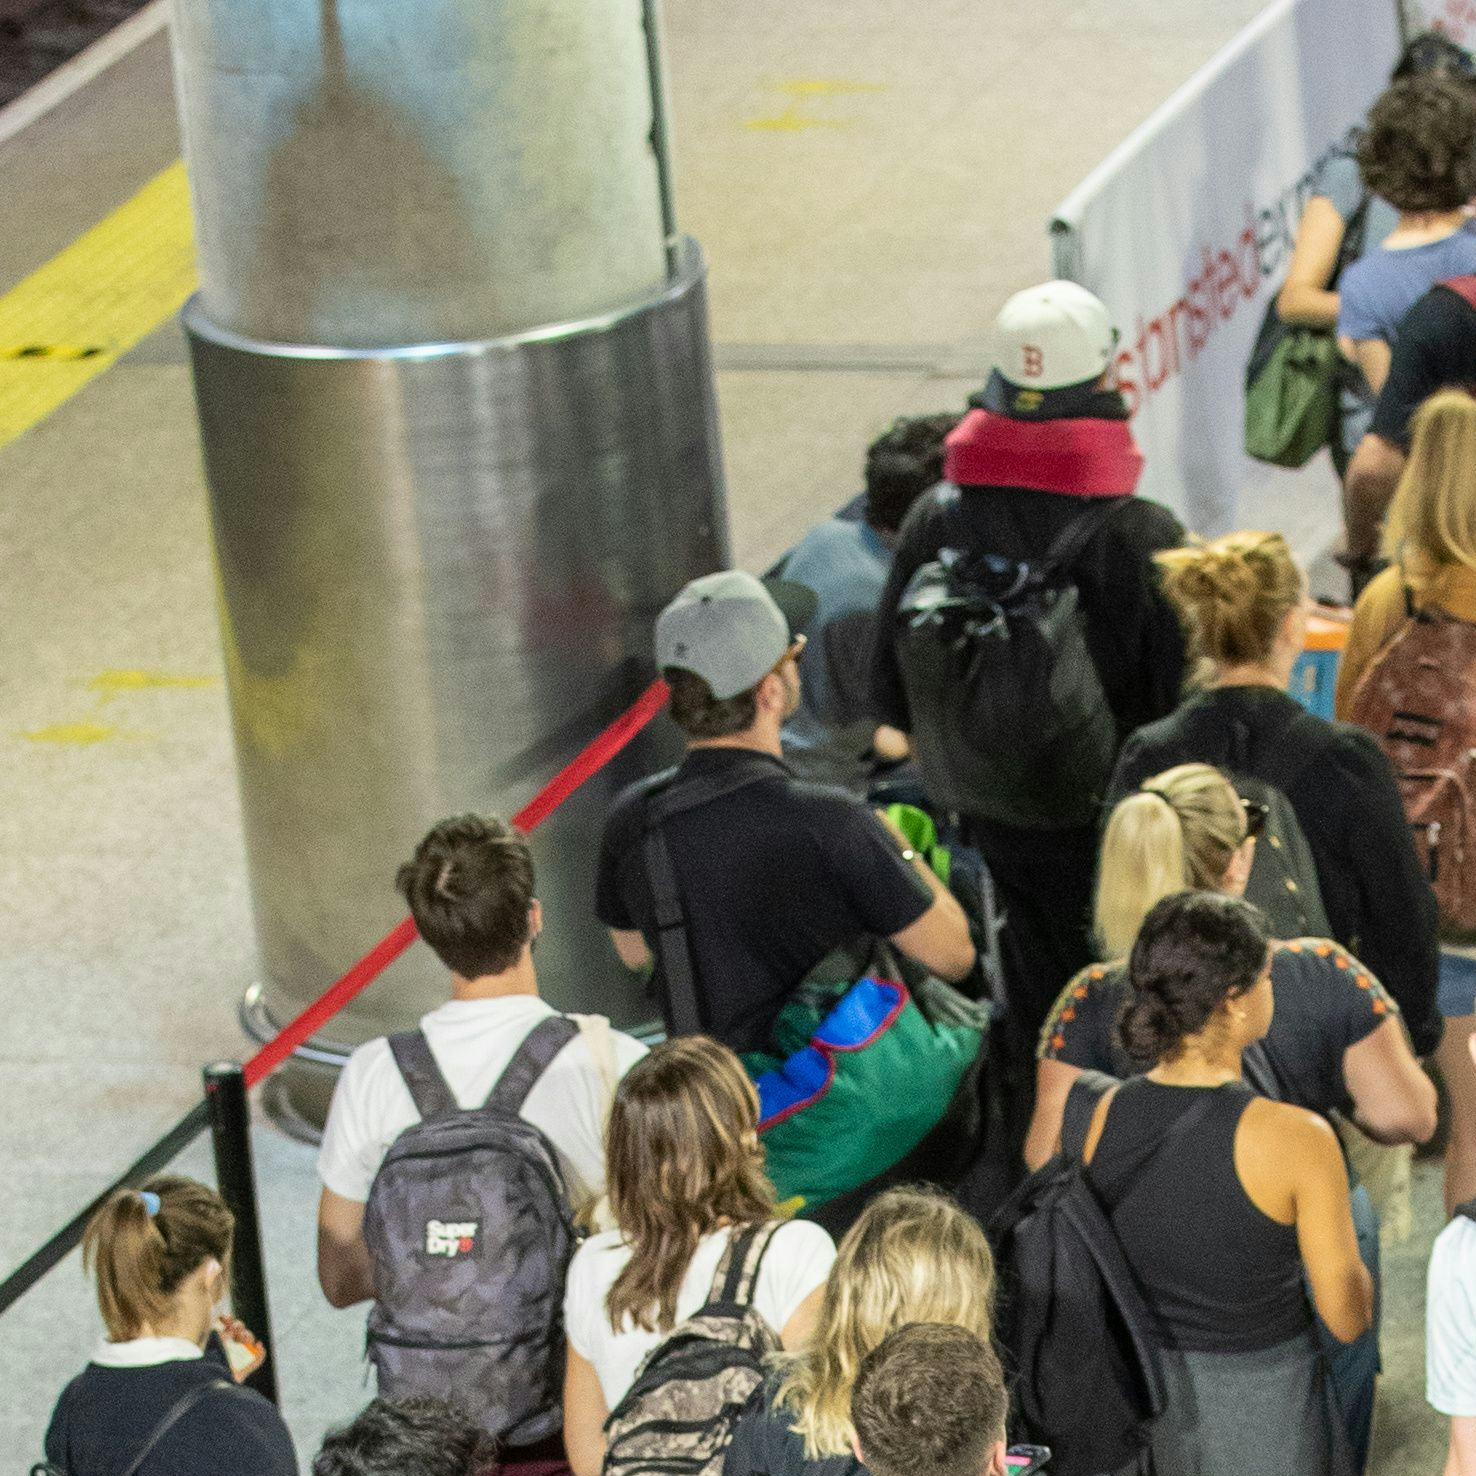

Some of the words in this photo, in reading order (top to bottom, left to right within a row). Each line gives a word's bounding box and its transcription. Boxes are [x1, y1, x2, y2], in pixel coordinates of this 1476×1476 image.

[1022, 344, 1043, 377] B
[427, 1220, 478, 1238] Super
[427, 1237, 459, 1257] Dry
